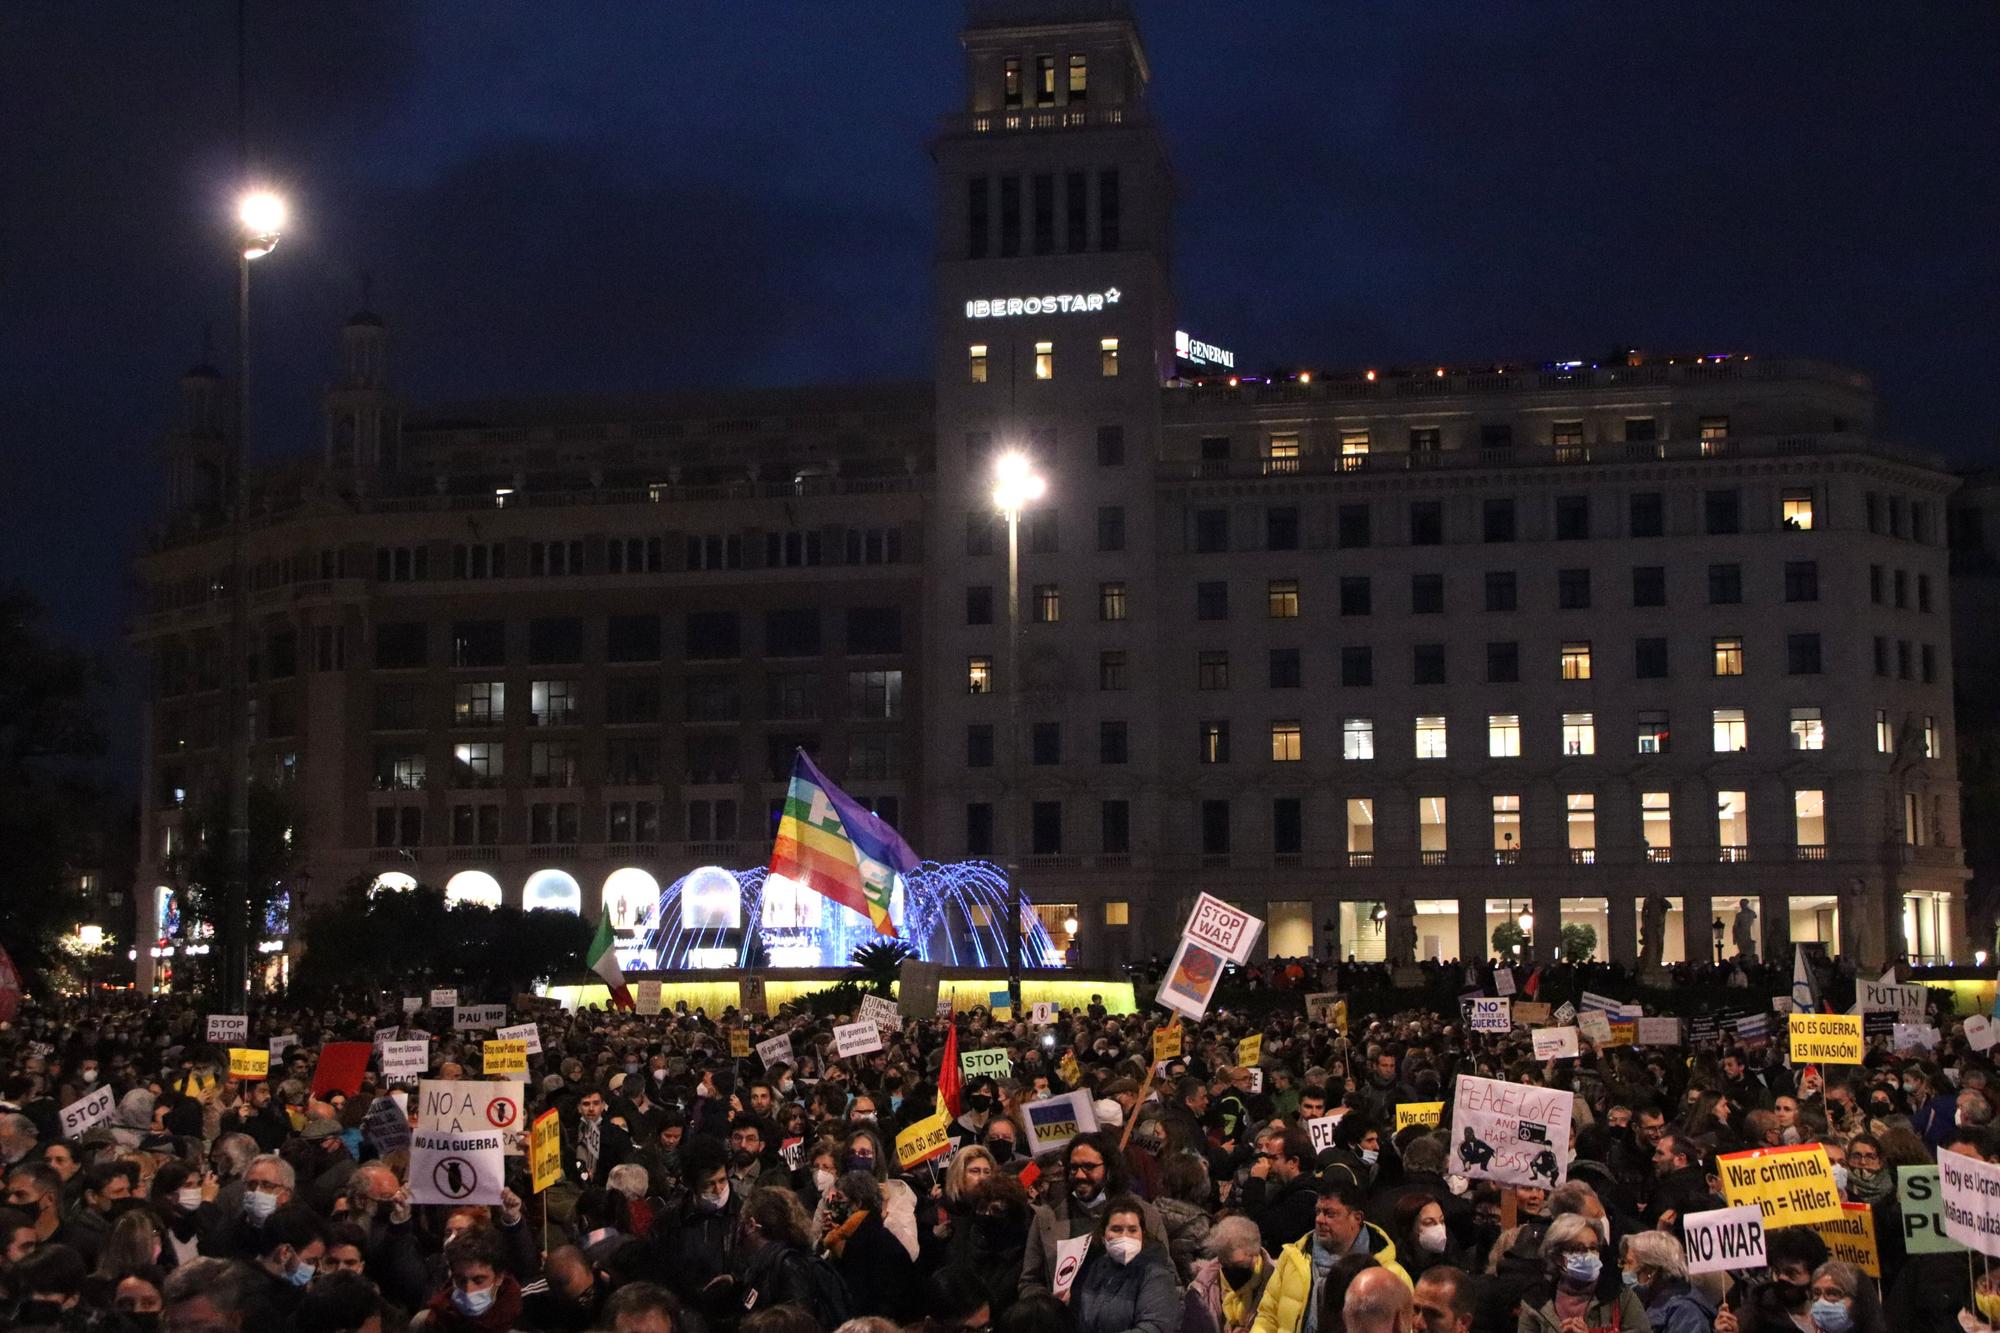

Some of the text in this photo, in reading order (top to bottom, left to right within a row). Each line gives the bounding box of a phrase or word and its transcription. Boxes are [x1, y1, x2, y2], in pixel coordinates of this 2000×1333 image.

[966, 295, 1103, 317] IBEROSTAR
[1189, 339, 1234, 367] GENERALI
[1202, 905, 1240, 930] STOP
[1199, 920, 1232, 945] WAR
[1867, 985, 1919, 1006] PUTIN
[458, 1012, 481, 1023] PAU
[1477, 1002, 1498, 1012] NO
[211, 1020, 244, 1028] STOP
[1472, 1019, 1508, 1028] GUERRES
[1790, 1021, 1805, 1034] NO
[1807, 1022, 1817, 1034] ES
[1820, 1022, 1860, 1037] GUERRA,
[208, 1031, 246, 1040] PUTIN
[965, 1054, 1004, 1067] STOP
[1795, 1042, 1858, 1058] ¡ES INVASIÓN!
[66, 1095, 109, 1128] STOP
[427, 1091, 476, 1116] NO A
[1399, 1111, 1417, 1123] War
[1495, 1118, 1517, 1130] AND
[1035, 1122, 1077, 1138] WAR
[415, 1137, 426, 1149] NO
[427, 1139, 435, 1150] A
[437, 1140, 450, 1151] LA
[452, 1138, 499, 1151] GUERRA
[899, 1142, 916, 1161] PUTIN
[916, 1137, 926, 1151] GO
[1726, 1155, 1827, 1187] War criminal,
[1944, 1163, 1961, 1193] Hoy
[1964, 1174, 1974, 1190] es
[1789, 1188, 1836, 1212] Hitler.
[1687, 1221, 1764, 1263] NO WAR
[1835, 1243, 1874, 1265] Hitler.
